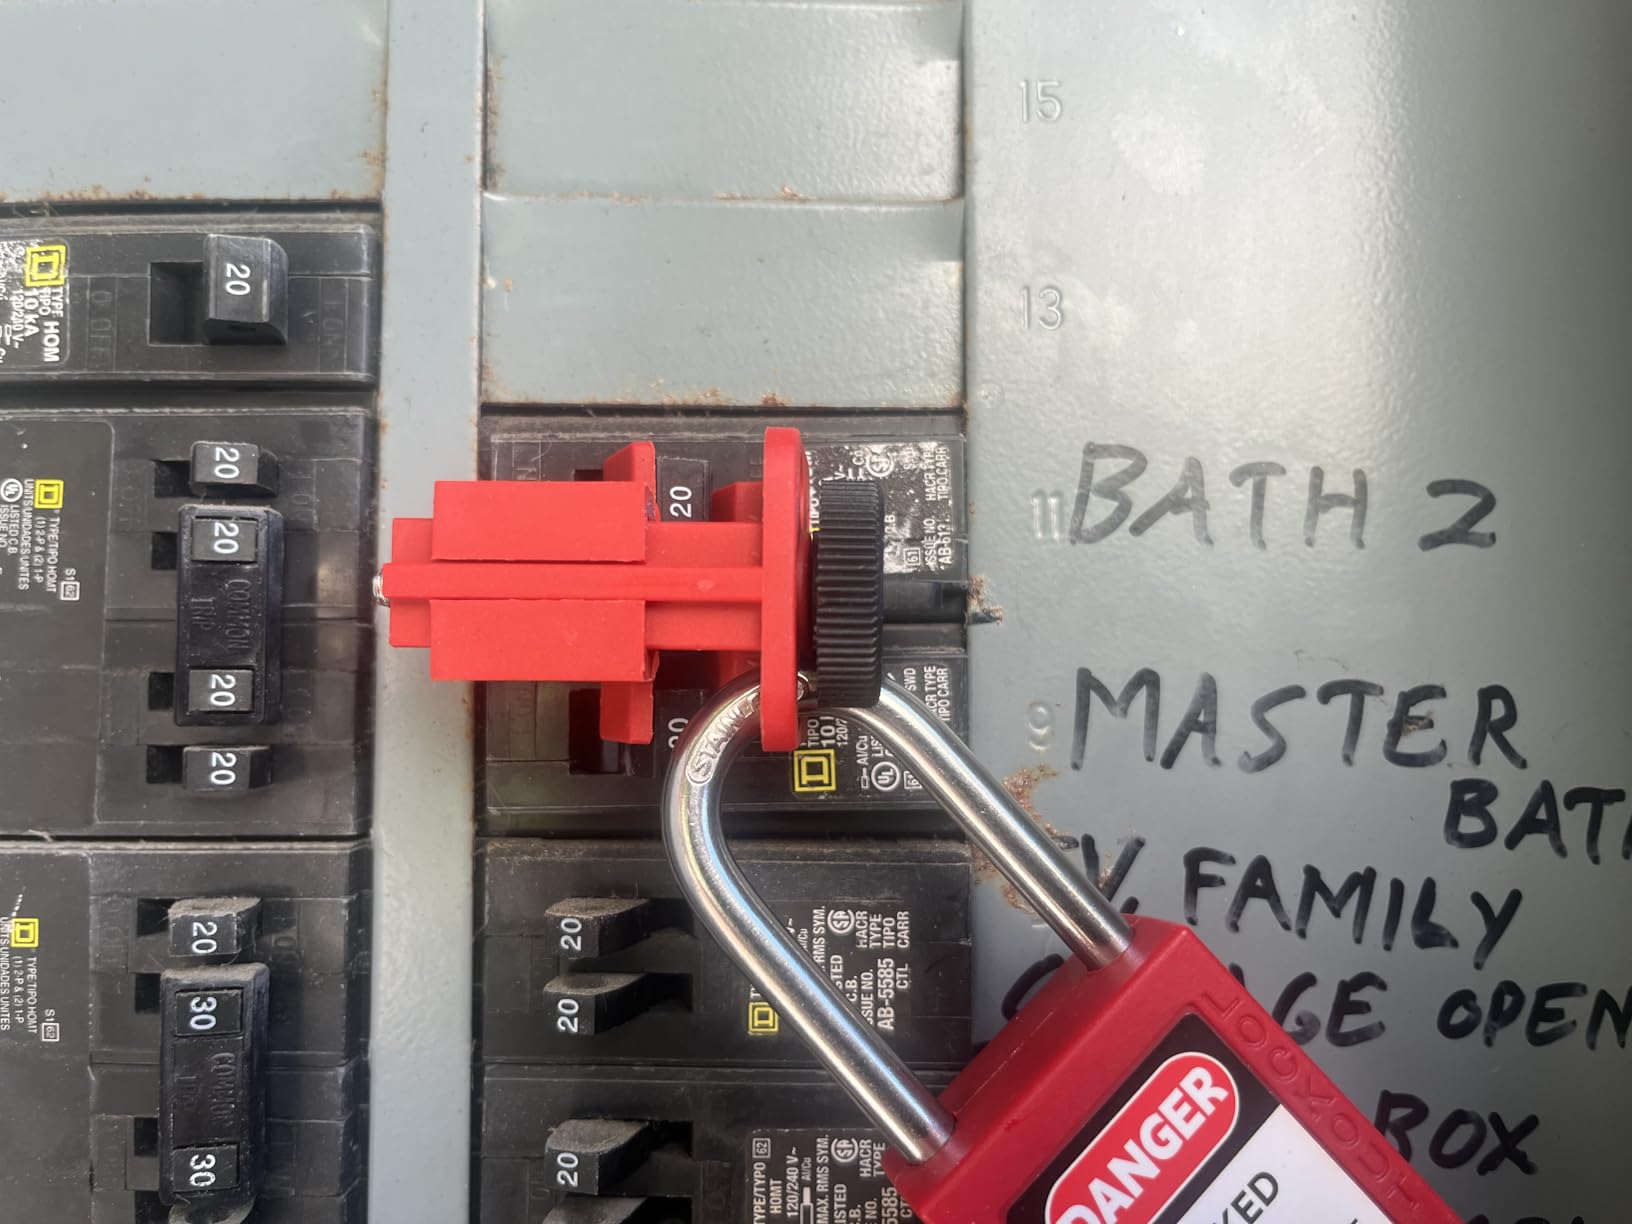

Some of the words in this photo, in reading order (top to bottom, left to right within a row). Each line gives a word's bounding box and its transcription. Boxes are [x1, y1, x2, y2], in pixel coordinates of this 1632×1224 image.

[1020, 79, 1062, 123] 15
[225, 262, 251, 296] 20
[25, 289, 38, 309] 10
[39, 287, 50, 315] TIPO
[1020, 286, 1063, 330] 13
[24, 314, 39, 336] kA
[44, 321, 59, 361] HOM
[214, 447, 240, 479] 20
[669, 486, 692, 518] 20
[924, 473, 935, 501] HACR
[1070, 441, 1366, 550] BATH
[1418, 478, 1498, 552] 2
[9, 505, 19, 536] LISTED
[1031, 488, 1062, 540] 11
[47, 516, 60, 564] TYPE/TIPO
[213, 522, 240, 554] 20
[46, 566, 57, 592] HOMT
[210, 674, 236, 707] 20
[904, 668, 916, 691] SWD
[924, 666, 936, 691] TYPE
[937, 667, 949, 697] CARR
[808, 719, 820, 747] TIPO
[821, 725, 835, 746] 10
[1071, 667, 1528, 772] MASTER
[856, 735, 868, 765] Al/Cu
[210, 753, 236, 786] 20
[813, 906, 826, 934] SYM.
[1183, 846, 1523, 971] FAMILY
[191, 921, 217, 955] 20
[560, 917, 583, 951] 20
[856, 910, 868, 948] HACR
[869, 914, 882, 948] TYPE
[883, 917, 895, 948] TIPO
[897, 911, 909, 948] CARR
[813, 937, 825, 962] RMS
[27, 956, 37, 1004] TYPE/TIPO
[861, 969, 873, 989] NO.
[896, 963, 908, 989] CTL
[877, 958, 894, 1030] AB-5585
[27, 1006, 37, 1034] HOMT
[189, 996, 217, 1031] 30
[557, 998, 580, 1033] 20
[1202, 990, 1420, 1210] LOCKOUT
[816, 1134, 829, 1163] SYM.
[859, 1139, 872, 1177] HACR
[1057, 1066, 1229, 1224] DANGER
[189, 1153, 217, 1187] 30
[557, 1152, 579, 1188] 20
[802, 1157, 812, 1181] Al/Cu
[817, 1166, 829, 1191] RMS
[770, 1178, 782, 1214] HOMT
[786, 1167, 799, 1218] 120/240
[834, 1184, 847, 1224] ISTED
